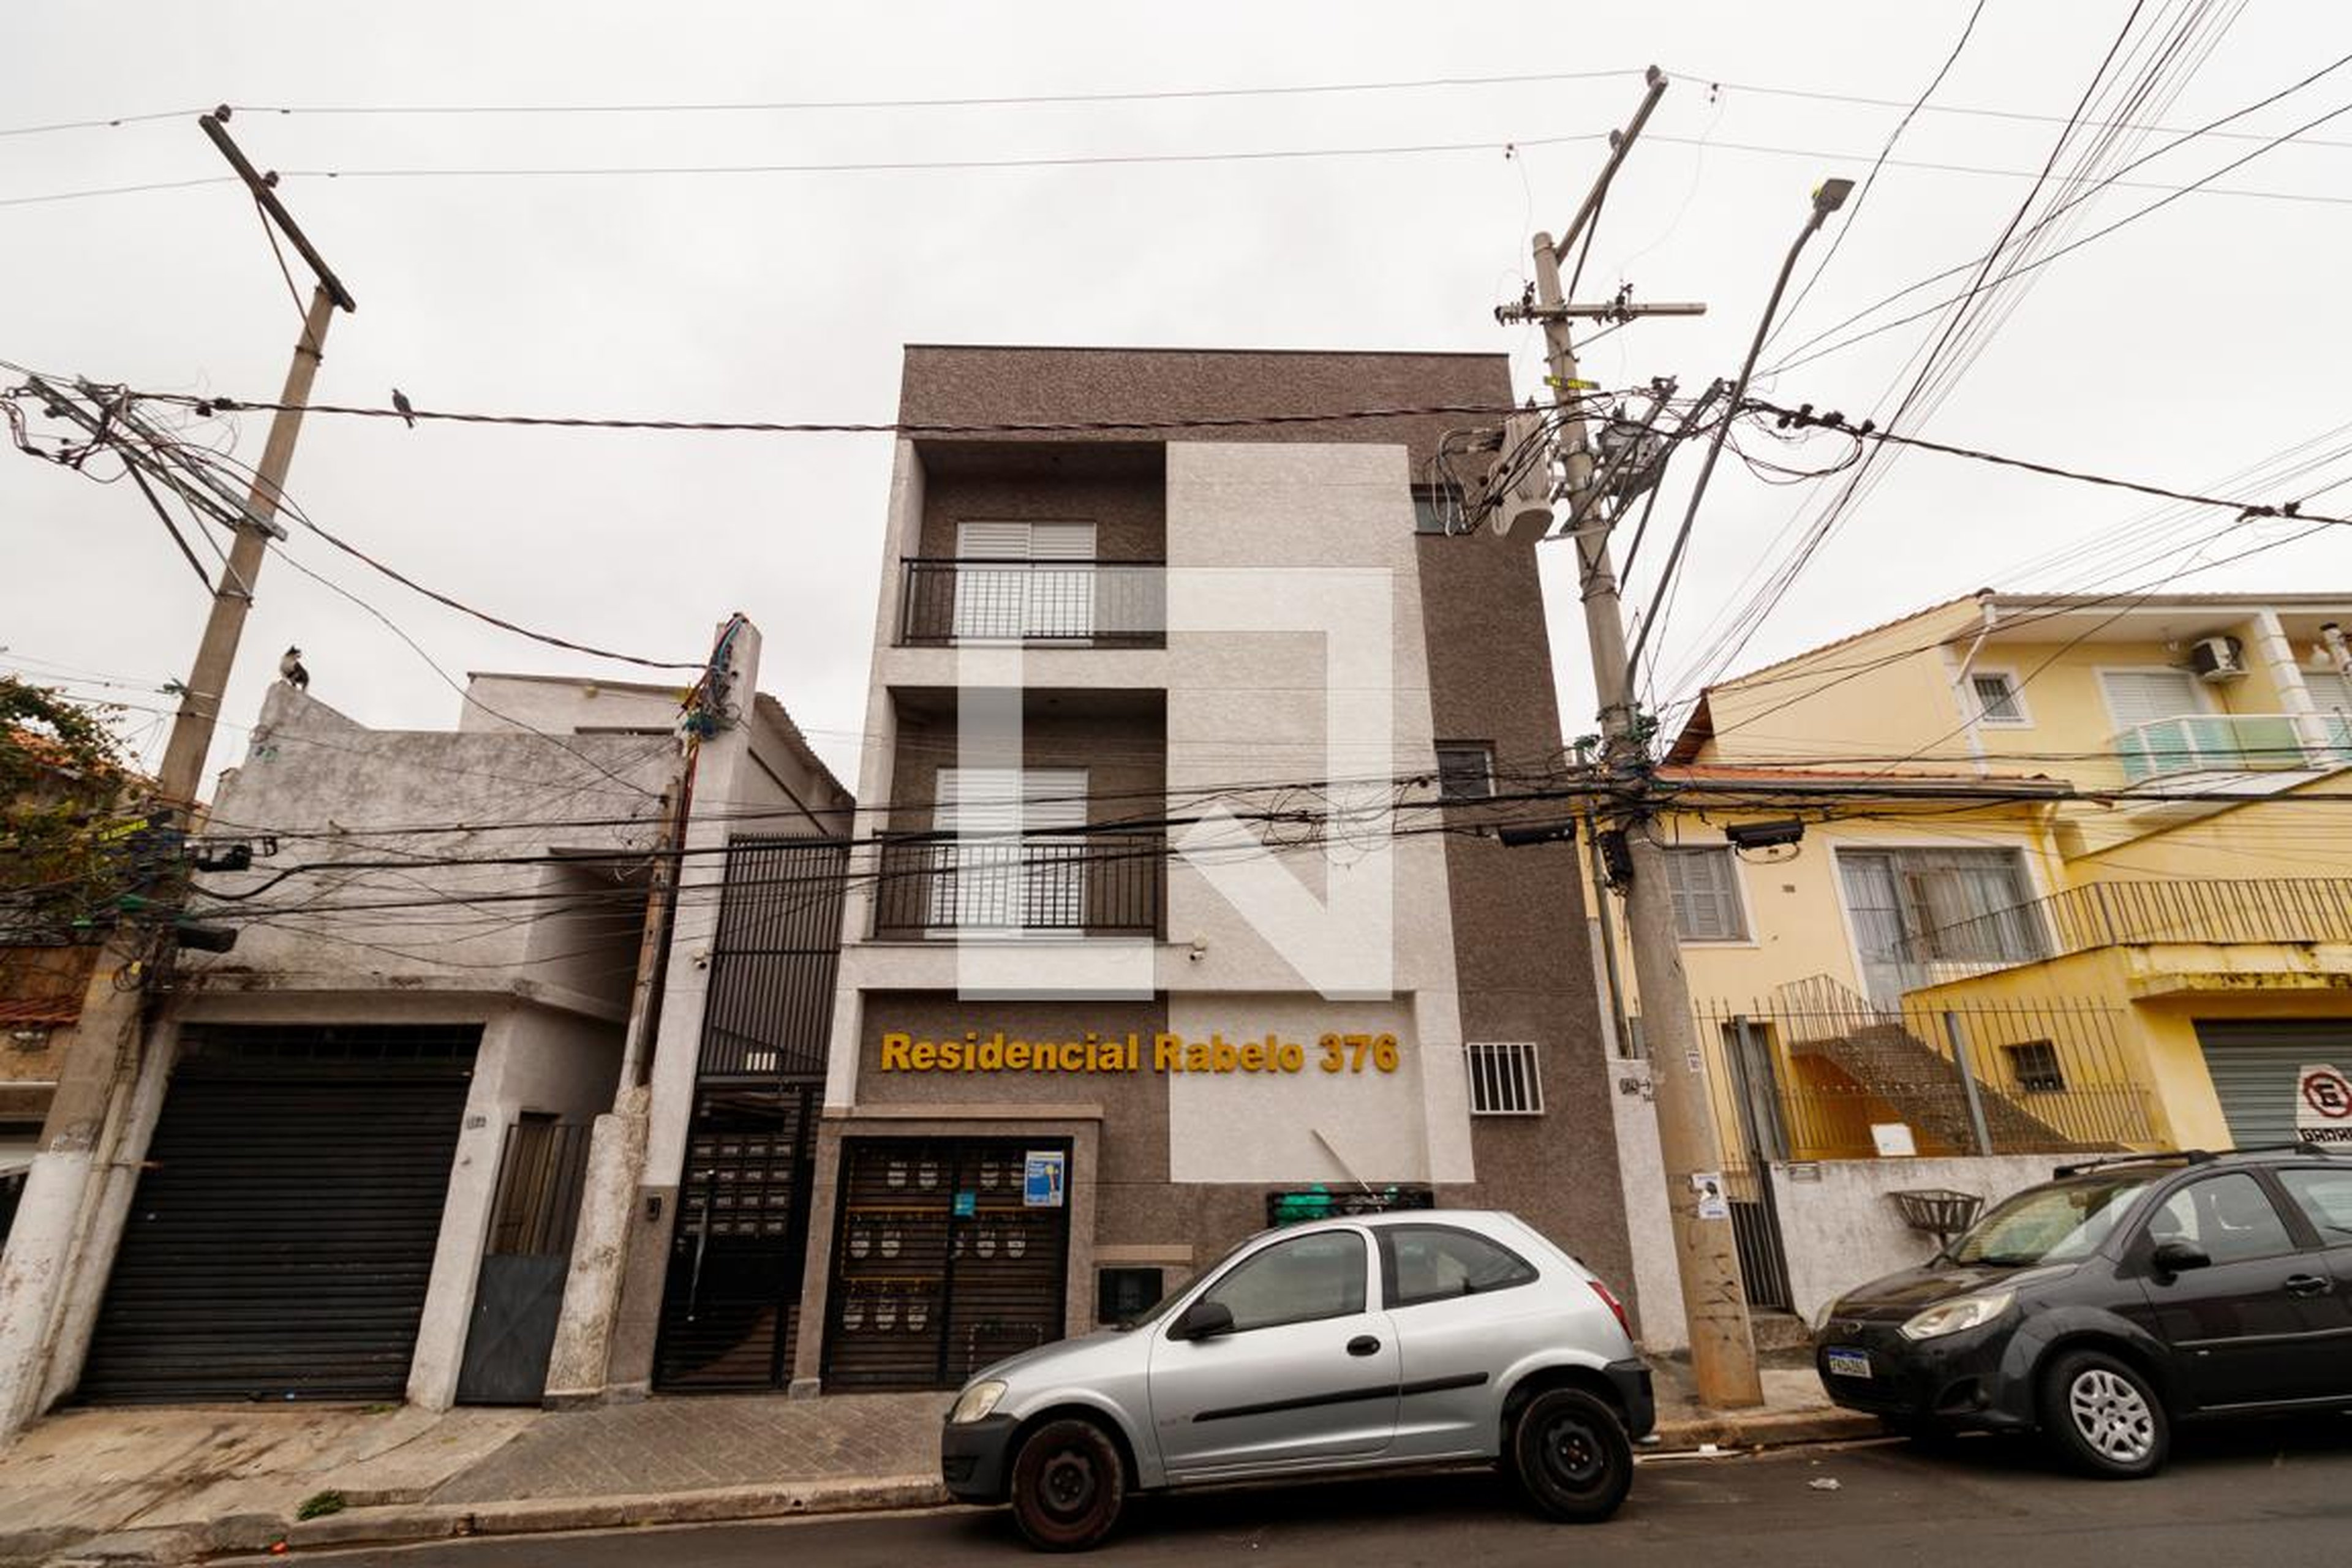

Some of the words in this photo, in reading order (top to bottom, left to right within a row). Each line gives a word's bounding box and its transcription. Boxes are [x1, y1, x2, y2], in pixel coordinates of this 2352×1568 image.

[881, 1031, 1139, 1072] Residencial
[1154, 1033, 1305, 1074] Rabelo
[1319, 1033, 1399, 1074] 376
